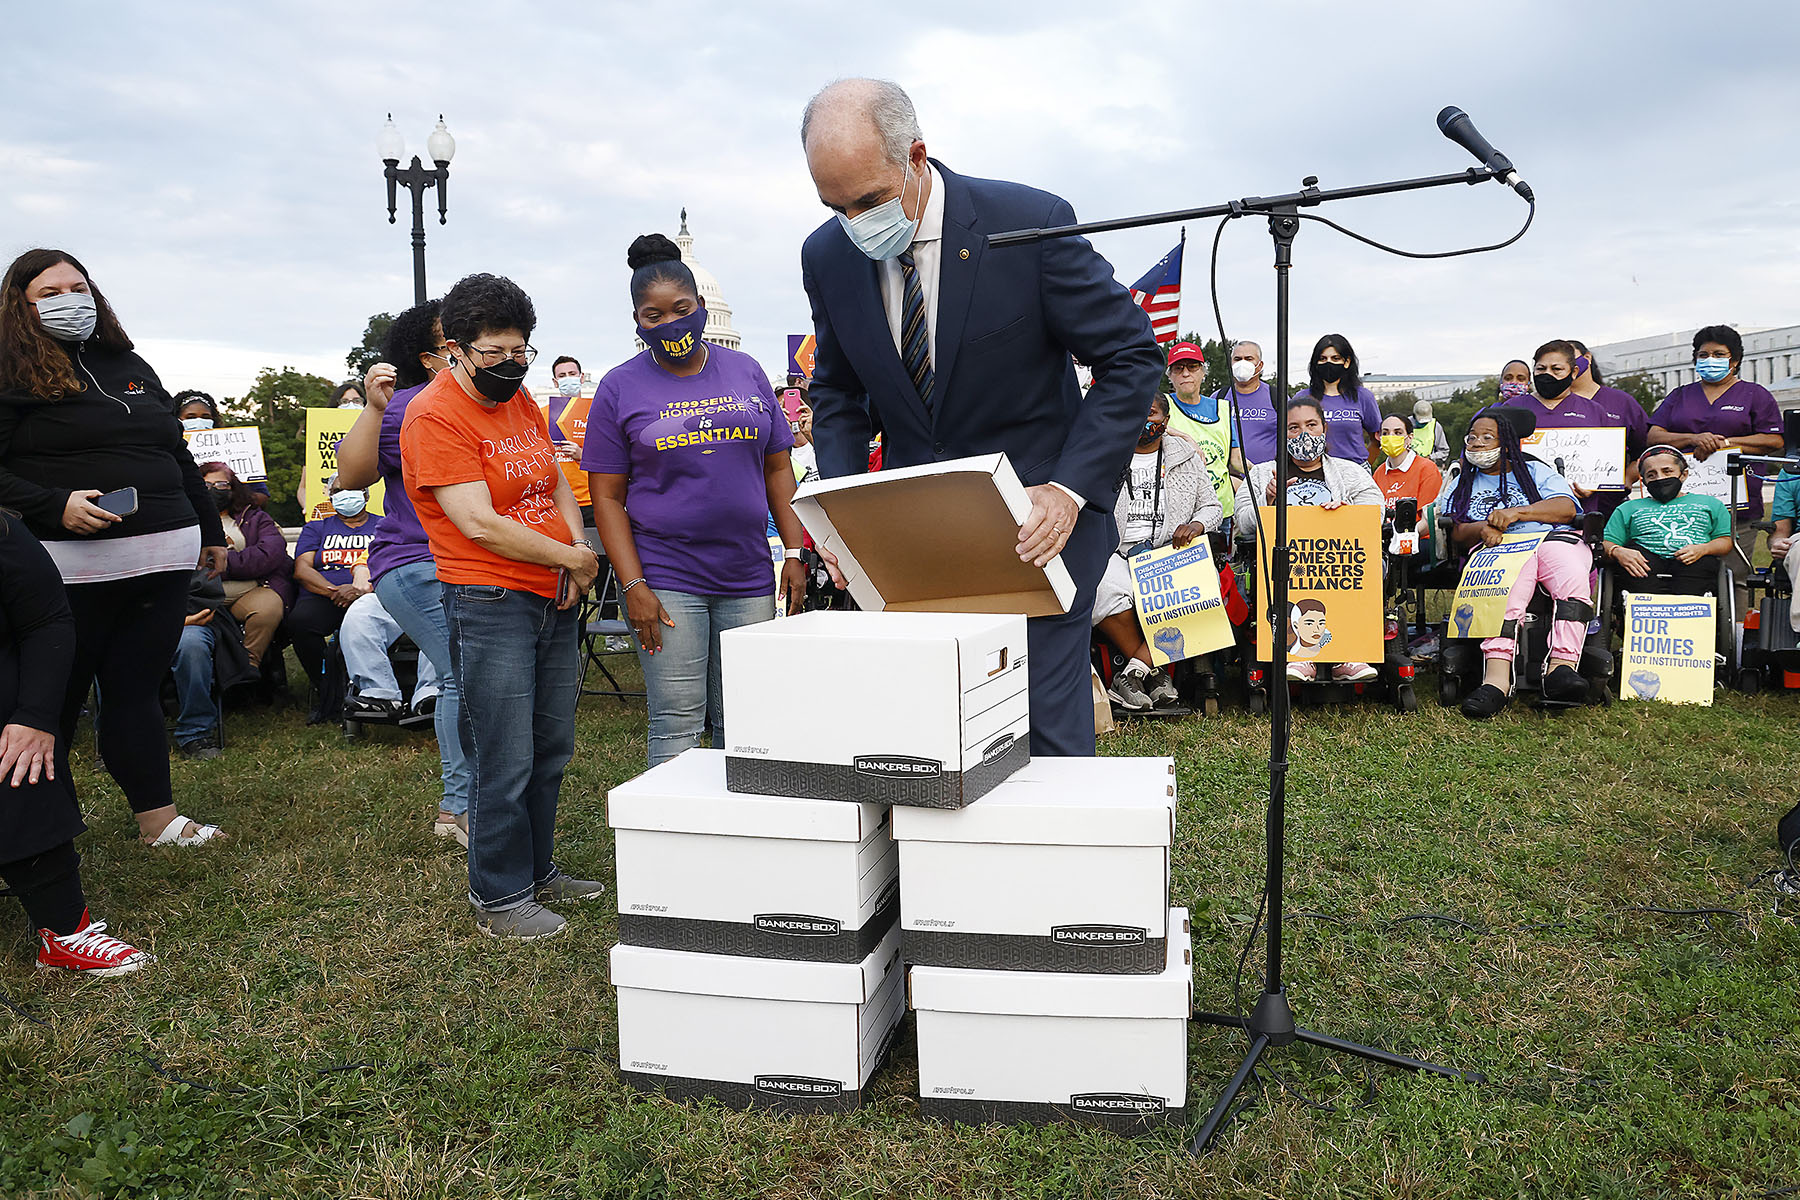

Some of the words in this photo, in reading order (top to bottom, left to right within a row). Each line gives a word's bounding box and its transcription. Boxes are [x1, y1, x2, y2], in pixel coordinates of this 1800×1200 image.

[661, 331, 695, 352] VOTE
[667, 396, 733, 409] 1199SEIU
[660, 403, 747, 420] HOMECARE
[1244, 408, 1267, 418] 2015
[699, 416, 713, 429] is
[655, 427, 759, 451] ESSENTIAL!
[1288, 538, 1364, 551] ATIONAL
[322, 550, 343, 563] FOR
[1135, 553, 1152, 563] ACLU
[1137, 556, 1177, 575] DISABILITY
[1176, 546, 1204, 561] RIGHTS
[1288, 551, 1367, 564] OMESTIC
[1470, 554, 1500, 569] OUR
[1139, 570, 1155, 580] ARE
[1155, 564, 1174, 575] CIVIL
[1174, 554, 1201, 568] RIGHTS
[1289, 564, 1364, 577] ORKERS
[1289, 577, 1363, 590] LLIANCE
[1461, 568, 1506, 587] HOMES
[1138, 574, 1175, 596] OUR
[1141, 586, 1201, 613] HOMES
[1458, 589, 1472, 599] NOT
[1471, 587, 1510, 598] INSTITUTIONS
[1145, 613, 1162, 626] NOT
[1163, 597, 1221, 621] INSTITUTIONS
[1631, 618, 1669, 636] OUR
[1630, 636, 1695, 657] HOMES
[1629, 655, 1648, 665] NOT
[1649, 656, 1712, 670] INSTITUTIONS
[858, 761, 912, 772] BANKERS
[912, 764, 938, 774] BOX
[759, 919, 811, 930] BANKERS
[812, 923, 837, 932] BOX
[1056, 931, 1114, 941] BANKERS
[1115, 932, 1142, 941] BOX
[759, 1080, 812, 1092] BANKERS
[813, 1084, 838, 1093] BOX
[1076, 1099, 1134, 1109] BANKERS
[1135, 1101, 1161, 1110] BOX
